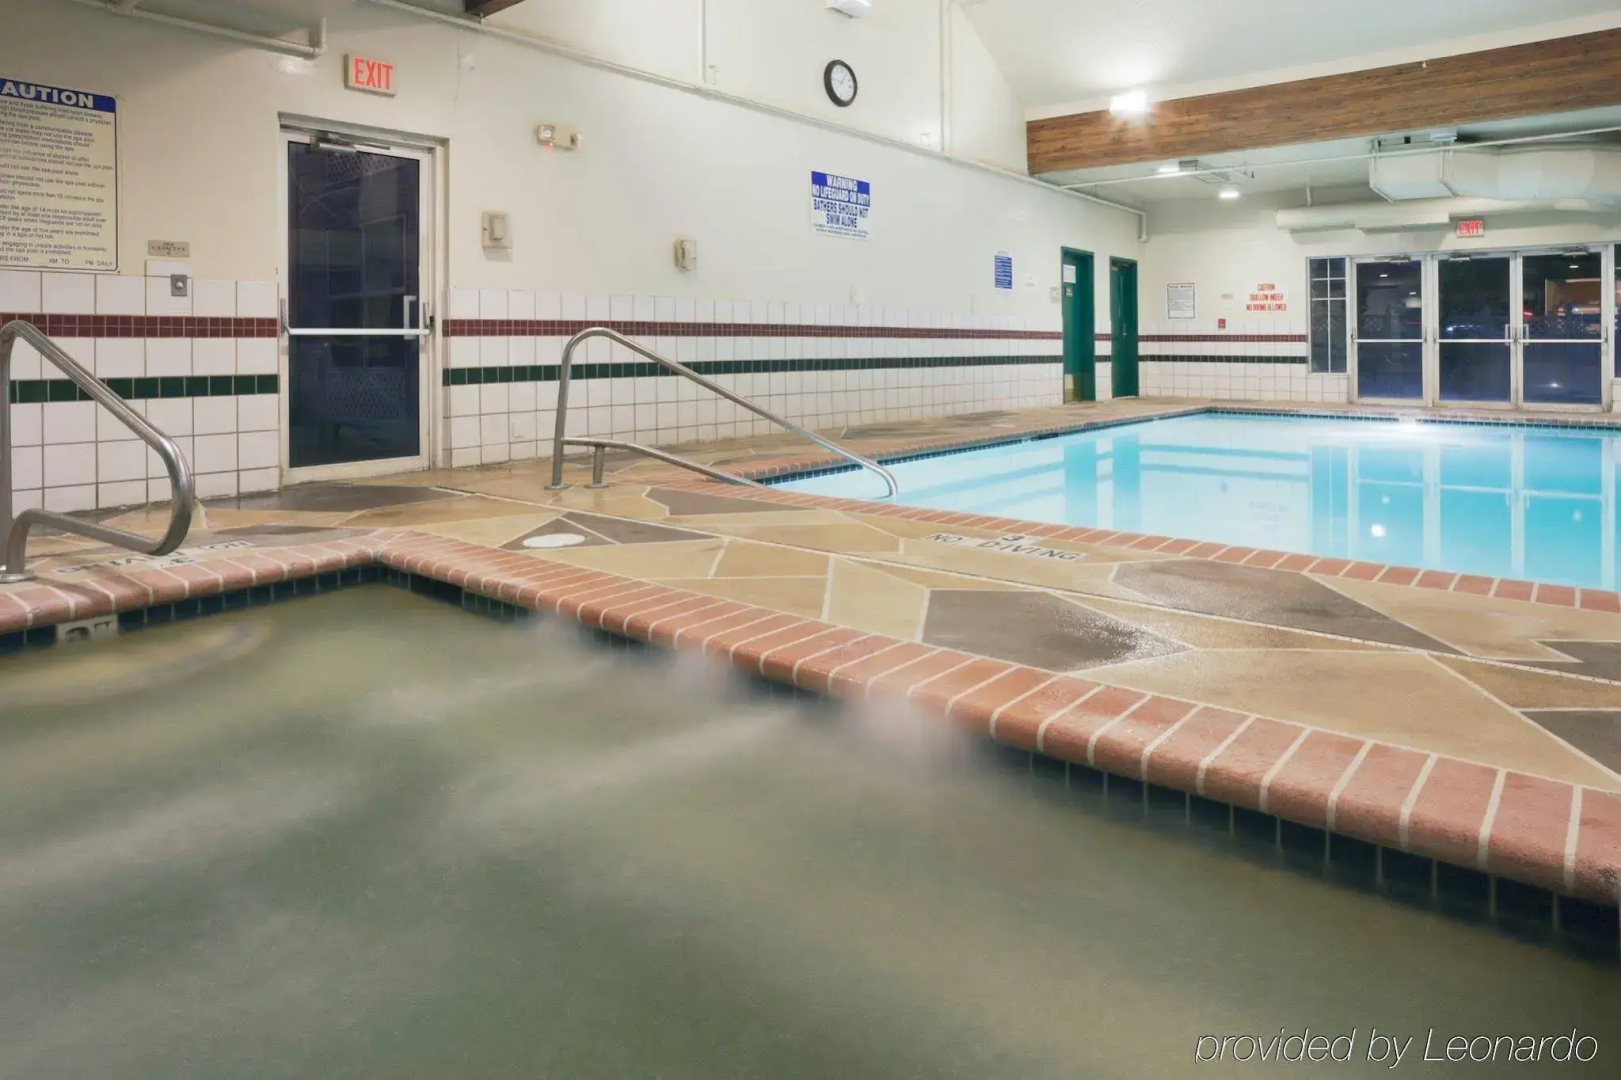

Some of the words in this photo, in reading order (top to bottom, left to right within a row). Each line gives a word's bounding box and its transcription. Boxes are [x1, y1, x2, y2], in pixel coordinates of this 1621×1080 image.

[354, 56, 393, 90] EXIT
[0, 81, 94, 108] AUTION
[826, 174, 858, 192] WARNING
[812, 184, 820, 198] NO
[820, 185, 849, 202] LIFEGUARD
[849, 191, 857, 204] ON
[857, 192, 869, 206] DUTY
[814, 199, 837, 213] BATHERS
[838, 203, 858, 217] SHOULD
[859, 206, 869, 218] NOT
[826, 213, 840, 225] SWIM
[841, 215, 857, 228] ALONE
[1459, 221, 1482, 234] EXIT
[927, 533, 963, 543] NO
[976, 540, 1080, 560] DIVING
